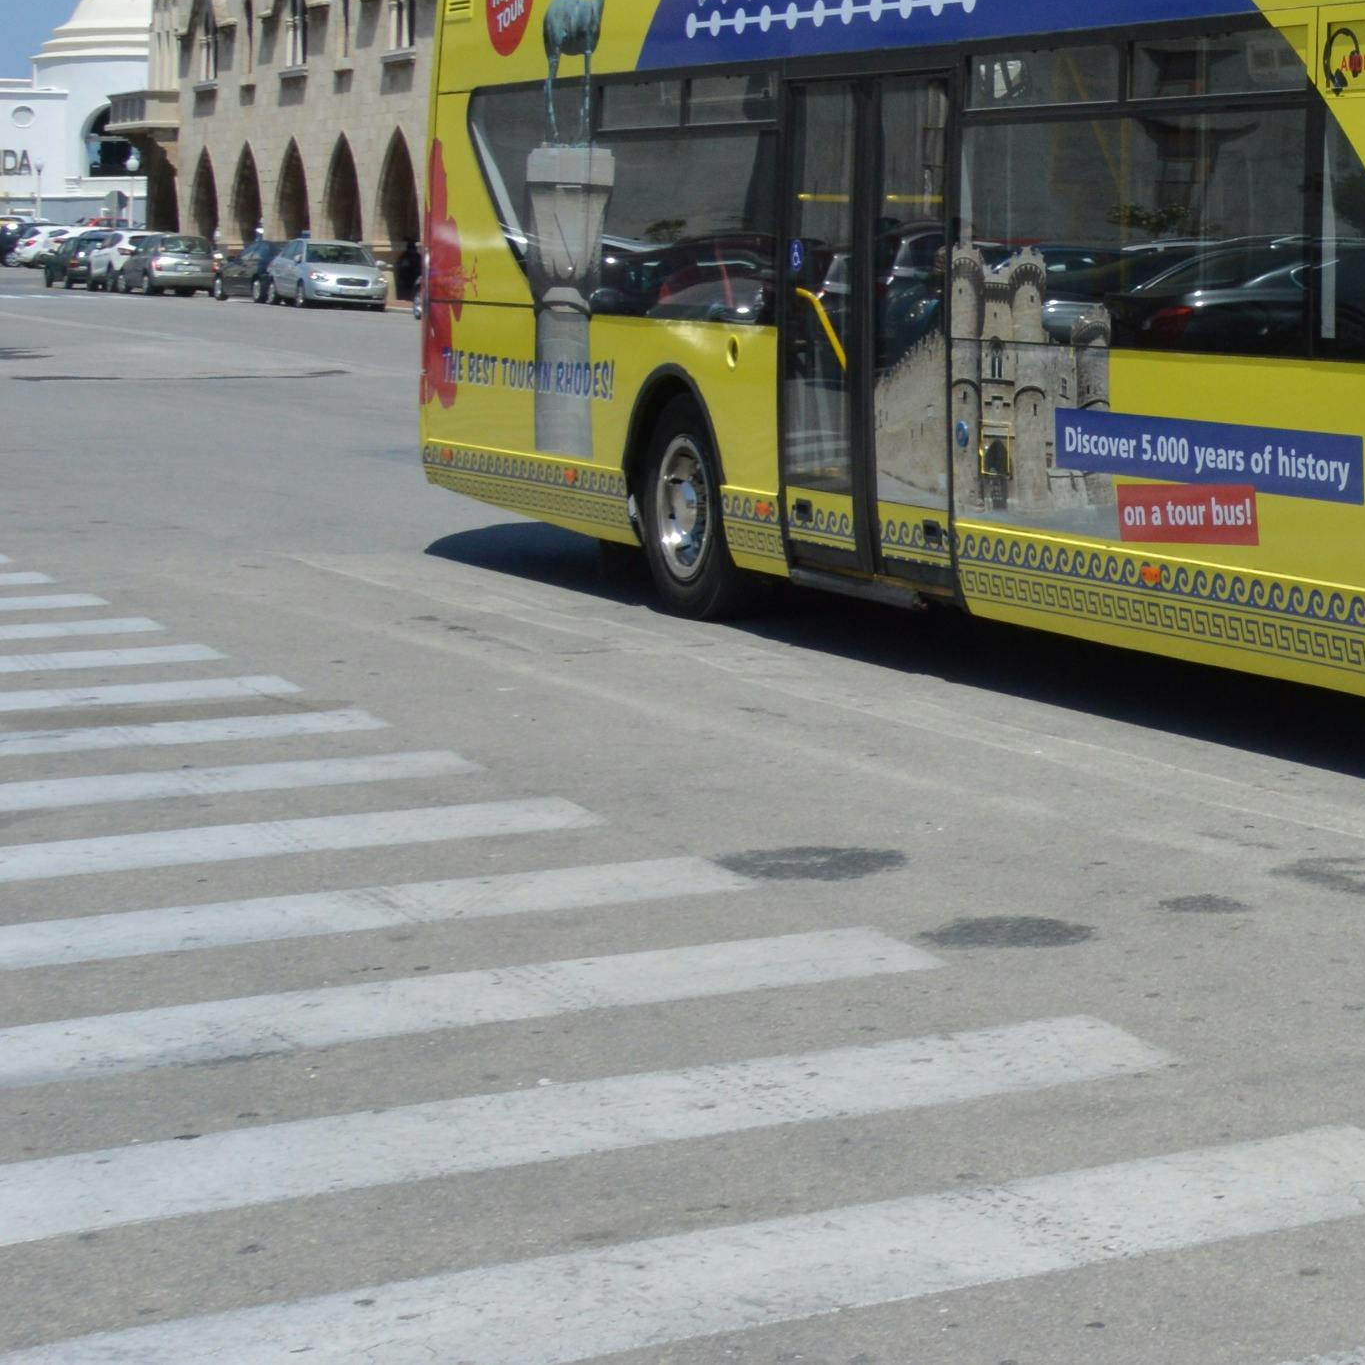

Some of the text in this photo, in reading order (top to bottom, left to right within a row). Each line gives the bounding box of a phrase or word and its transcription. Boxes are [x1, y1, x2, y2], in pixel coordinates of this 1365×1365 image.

[442, 346, 615, 402] THE BEST TOUR IN RHODES!
[1064, 426, 1351, 491] Discover 5.000 years of history
[1124, 497, 1252, 526] on a tour bus!
